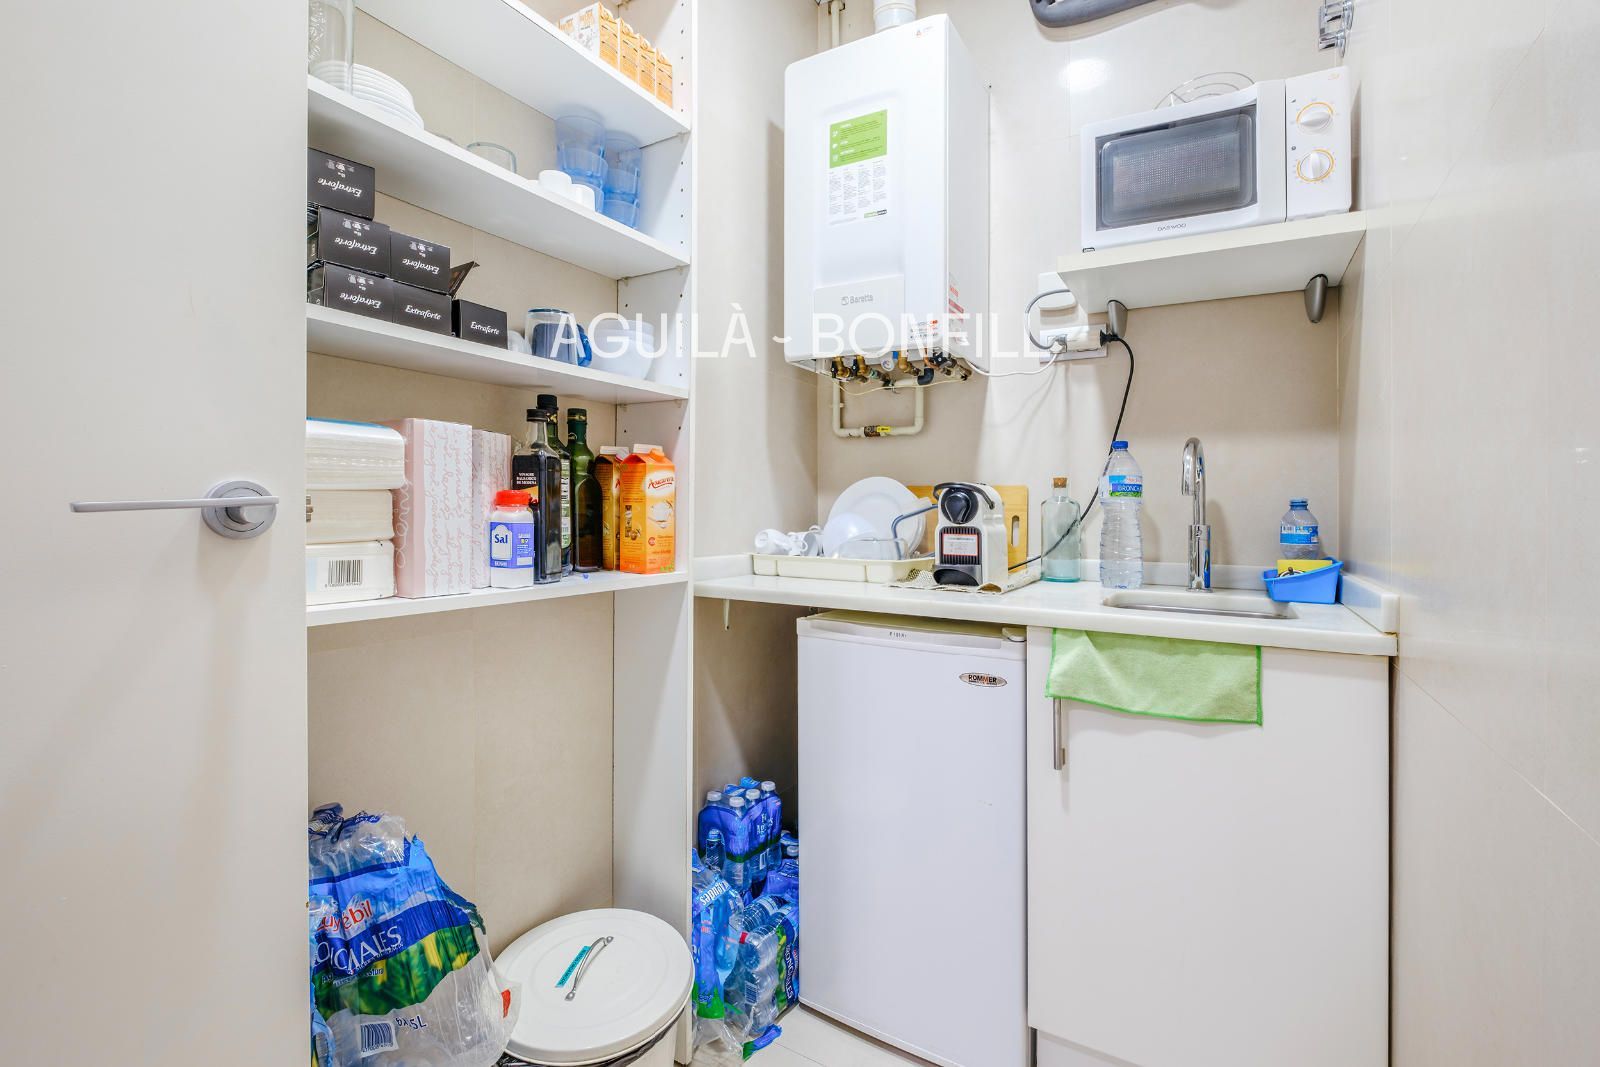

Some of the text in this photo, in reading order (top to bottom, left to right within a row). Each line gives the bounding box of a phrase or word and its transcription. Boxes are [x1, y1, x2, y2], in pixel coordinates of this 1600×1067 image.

[317, 177, 362, 198] Extraforte
[334, 237, 378, 255] Extraforte
[402, 258, 440, 275] Extraforte
[339, 292, 382, 309] Extraforte
[404, 304, 442, 320] Extraforte
[470, 321, 500, 335] Extraforte
[494, 533, 508, 544] Sal
[968, 674, 997, 684] ROMMER
